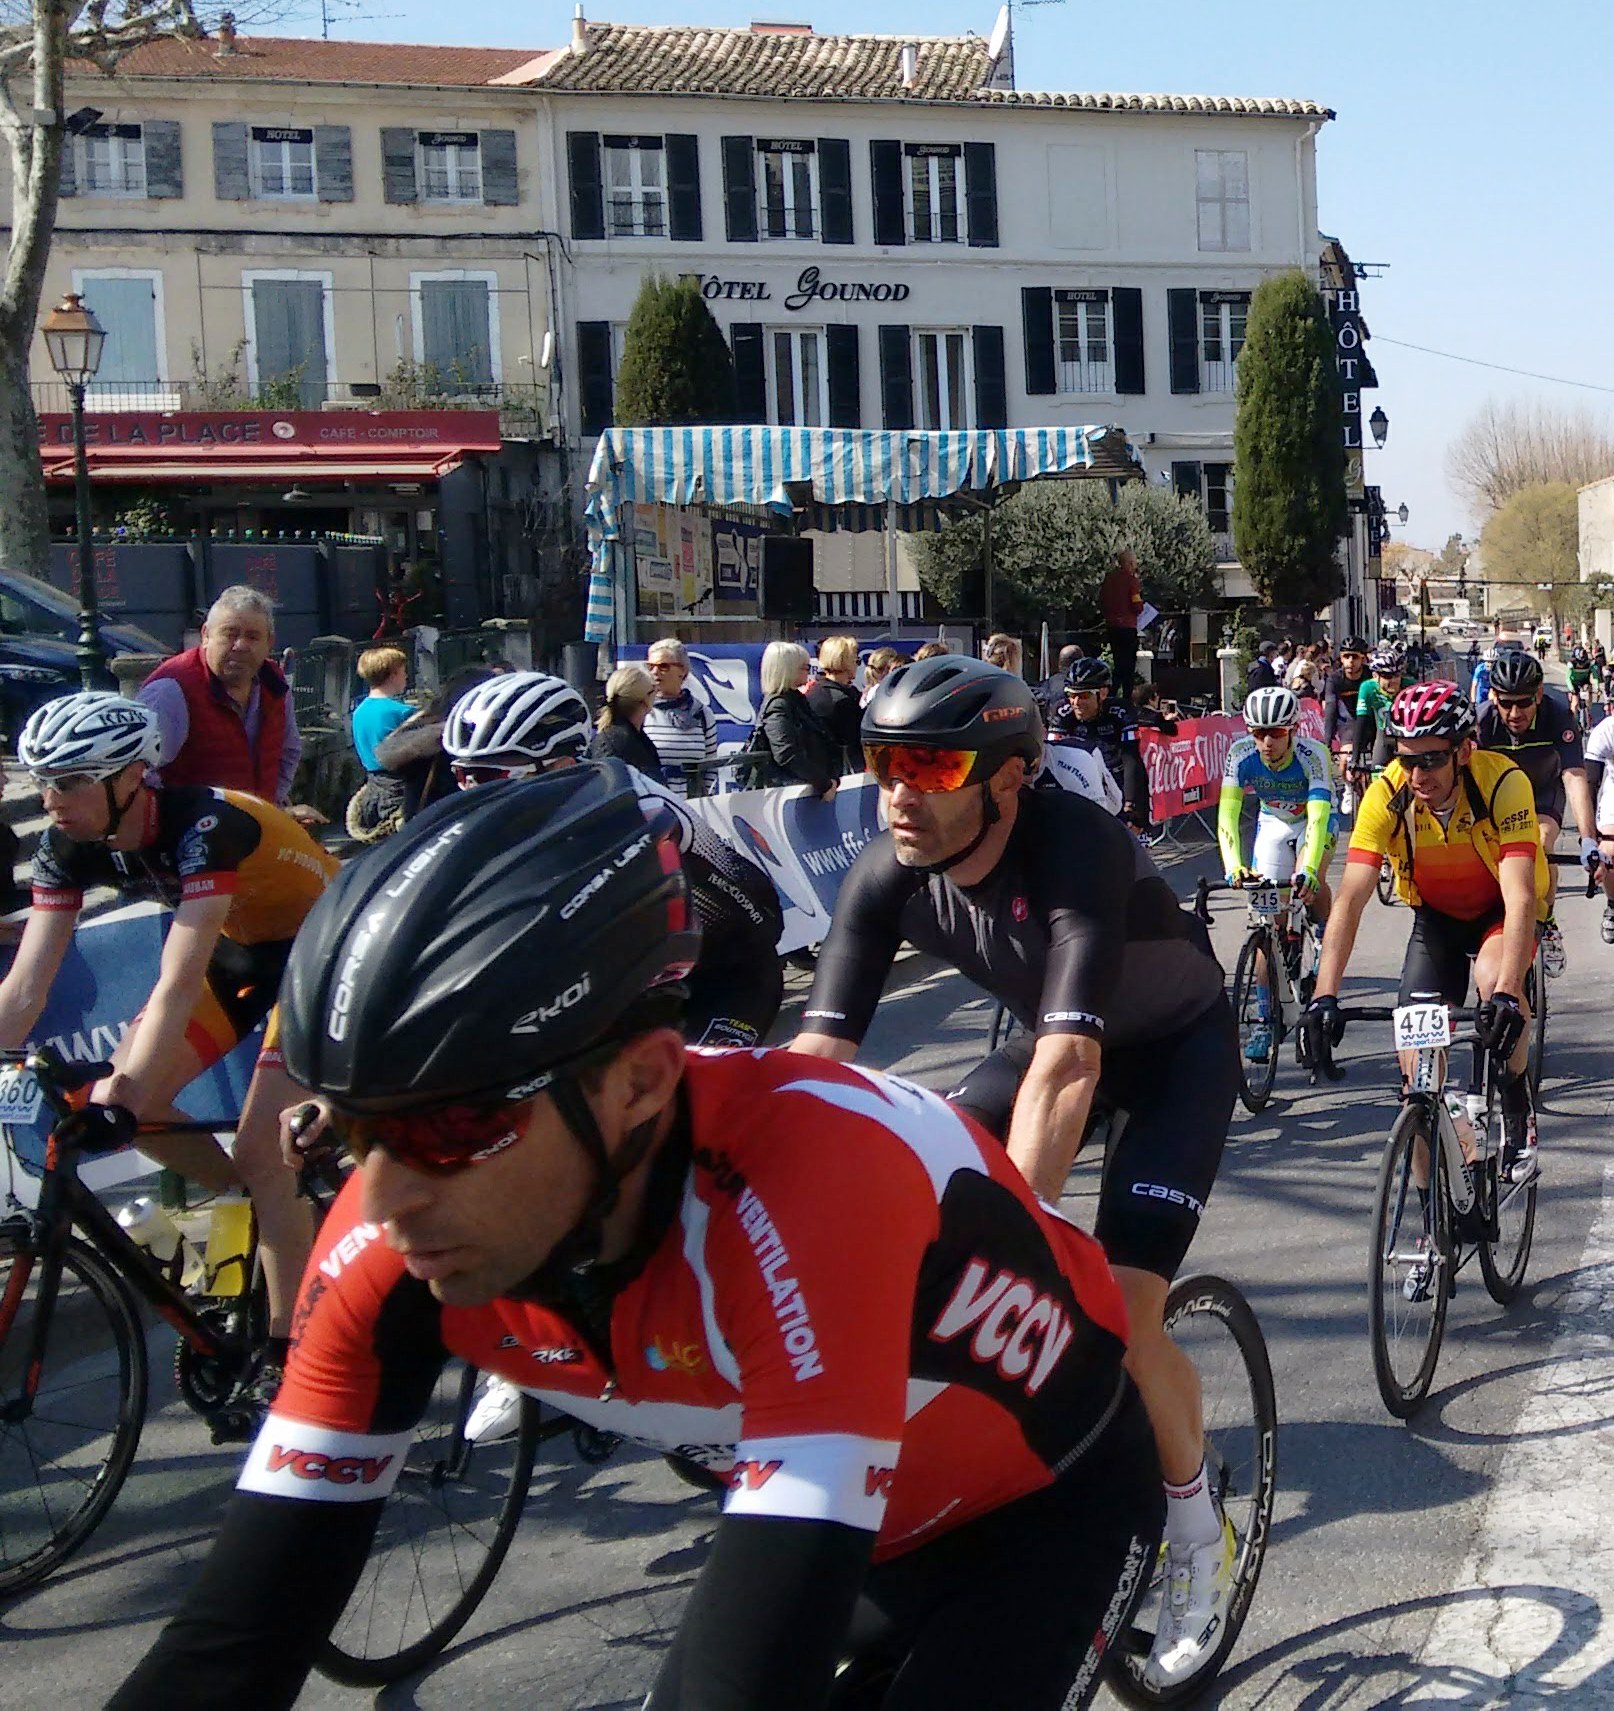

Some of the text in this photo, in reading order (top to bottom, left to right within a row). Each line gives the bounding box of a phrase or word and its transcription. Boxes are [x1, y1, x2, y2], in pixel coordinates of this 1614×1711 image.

[1336, 290, 1361, 448] HÔTEL
[110, 422, 146, 444] LA
[158, 421, 261, 445] PLACE
[366, 426, 440, 441] COMPTOIR
[385, 821, 464, 899] LIGHT
[560, 867, 616, 921] CORSA
[1250, 891, 1279, 907] 215
[327, 911, 386, 1043] CORSA
[1400, 1008, 1444, 1033] 475
[735, 1186, 825, 1383] VENTILATION
[928, 1255, 1076, 1398] VCCV
[265, 1443, 395, 1486] VCCV
